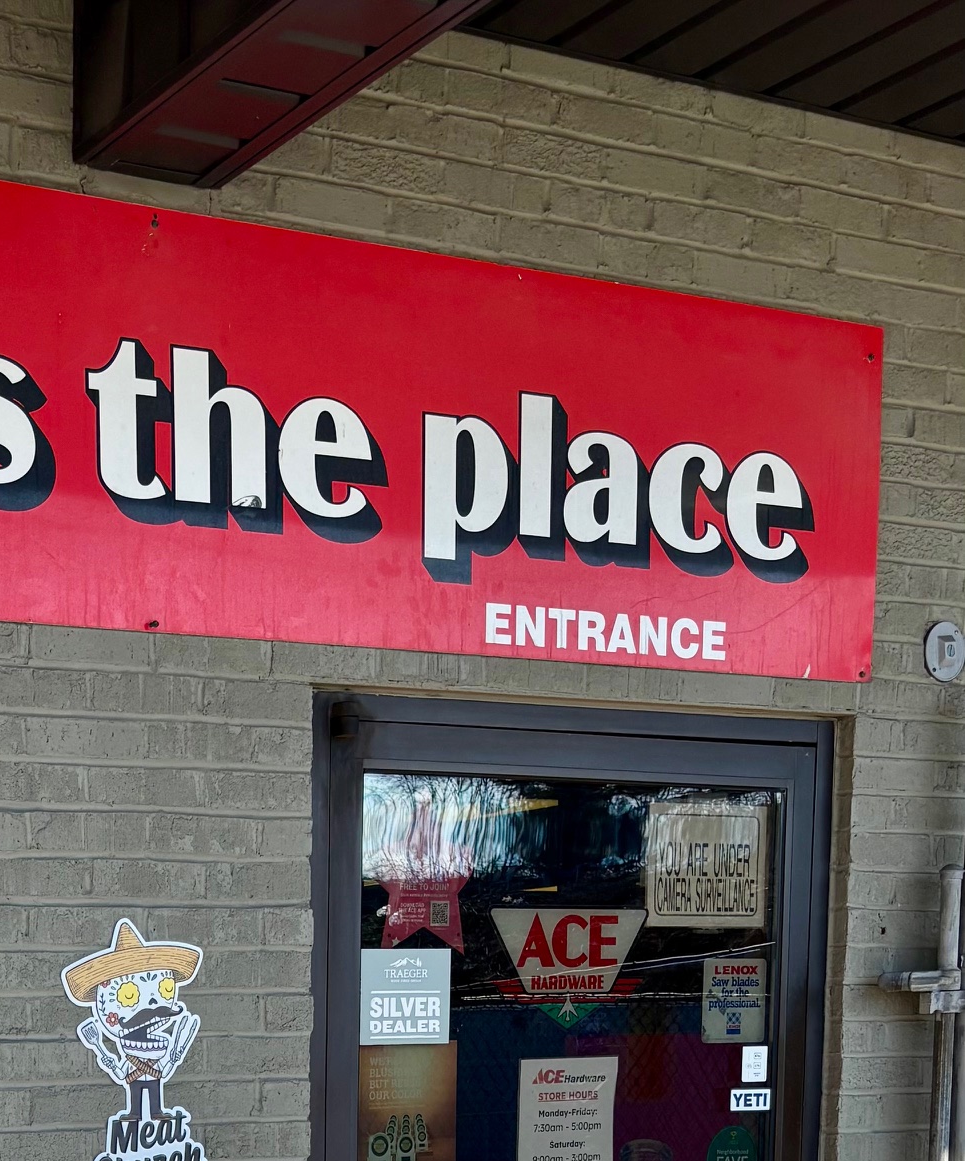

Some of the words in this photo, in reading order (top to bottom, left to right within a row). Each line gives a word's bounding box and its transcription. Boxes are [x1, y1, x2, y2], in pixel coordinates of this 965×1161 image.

[87, 338, 376, 518] the
[423, 391, 804, 561] place
[484, 601, 727, 662] ENTRANCE
[658, 841, 682, 876] YOU
[686, 842, 709, 877] ARE
[713, 843, 751, 877] UNDER
[656, 877, 692, 912] CAMERA
[695, 878, 755, 913] SURVEILLANCE
[517, 912, 619, 968] ACE
[384, 969, 428, 978] TRAEGER
[714, 965, 759, 975] LENOX
[531, 975, 604, 990] HARDWARE
[711, 976, 729, 987] Saw
[731, 976, 760, 987] blades
[721, 987, 735, 997] for
[736, 987, 750, 997] the
[369, 997, 440, 1018] SILVER
[369, 1020, 441, 1034] DEALER
[532, 1068, 565, 1084] ACE
[564, 1074, 606, 1084] Hardware
[369, 1090, 389, 1100] OUR
[538, 1092, 566, 1101] STORE
[569, 1090, 598, 1100] HOURS
[732, 1093, 768, 1107] YETI
[538, 1107, 597, 1118] Monday-Friday:
[110, 1110, 186, 1154] Meat
[533, 1124, 564, 1133] 7:30am
[571, 1122, 602, 1134] 5:00pm
[549, 1140, 585, 1149] Saturday:
